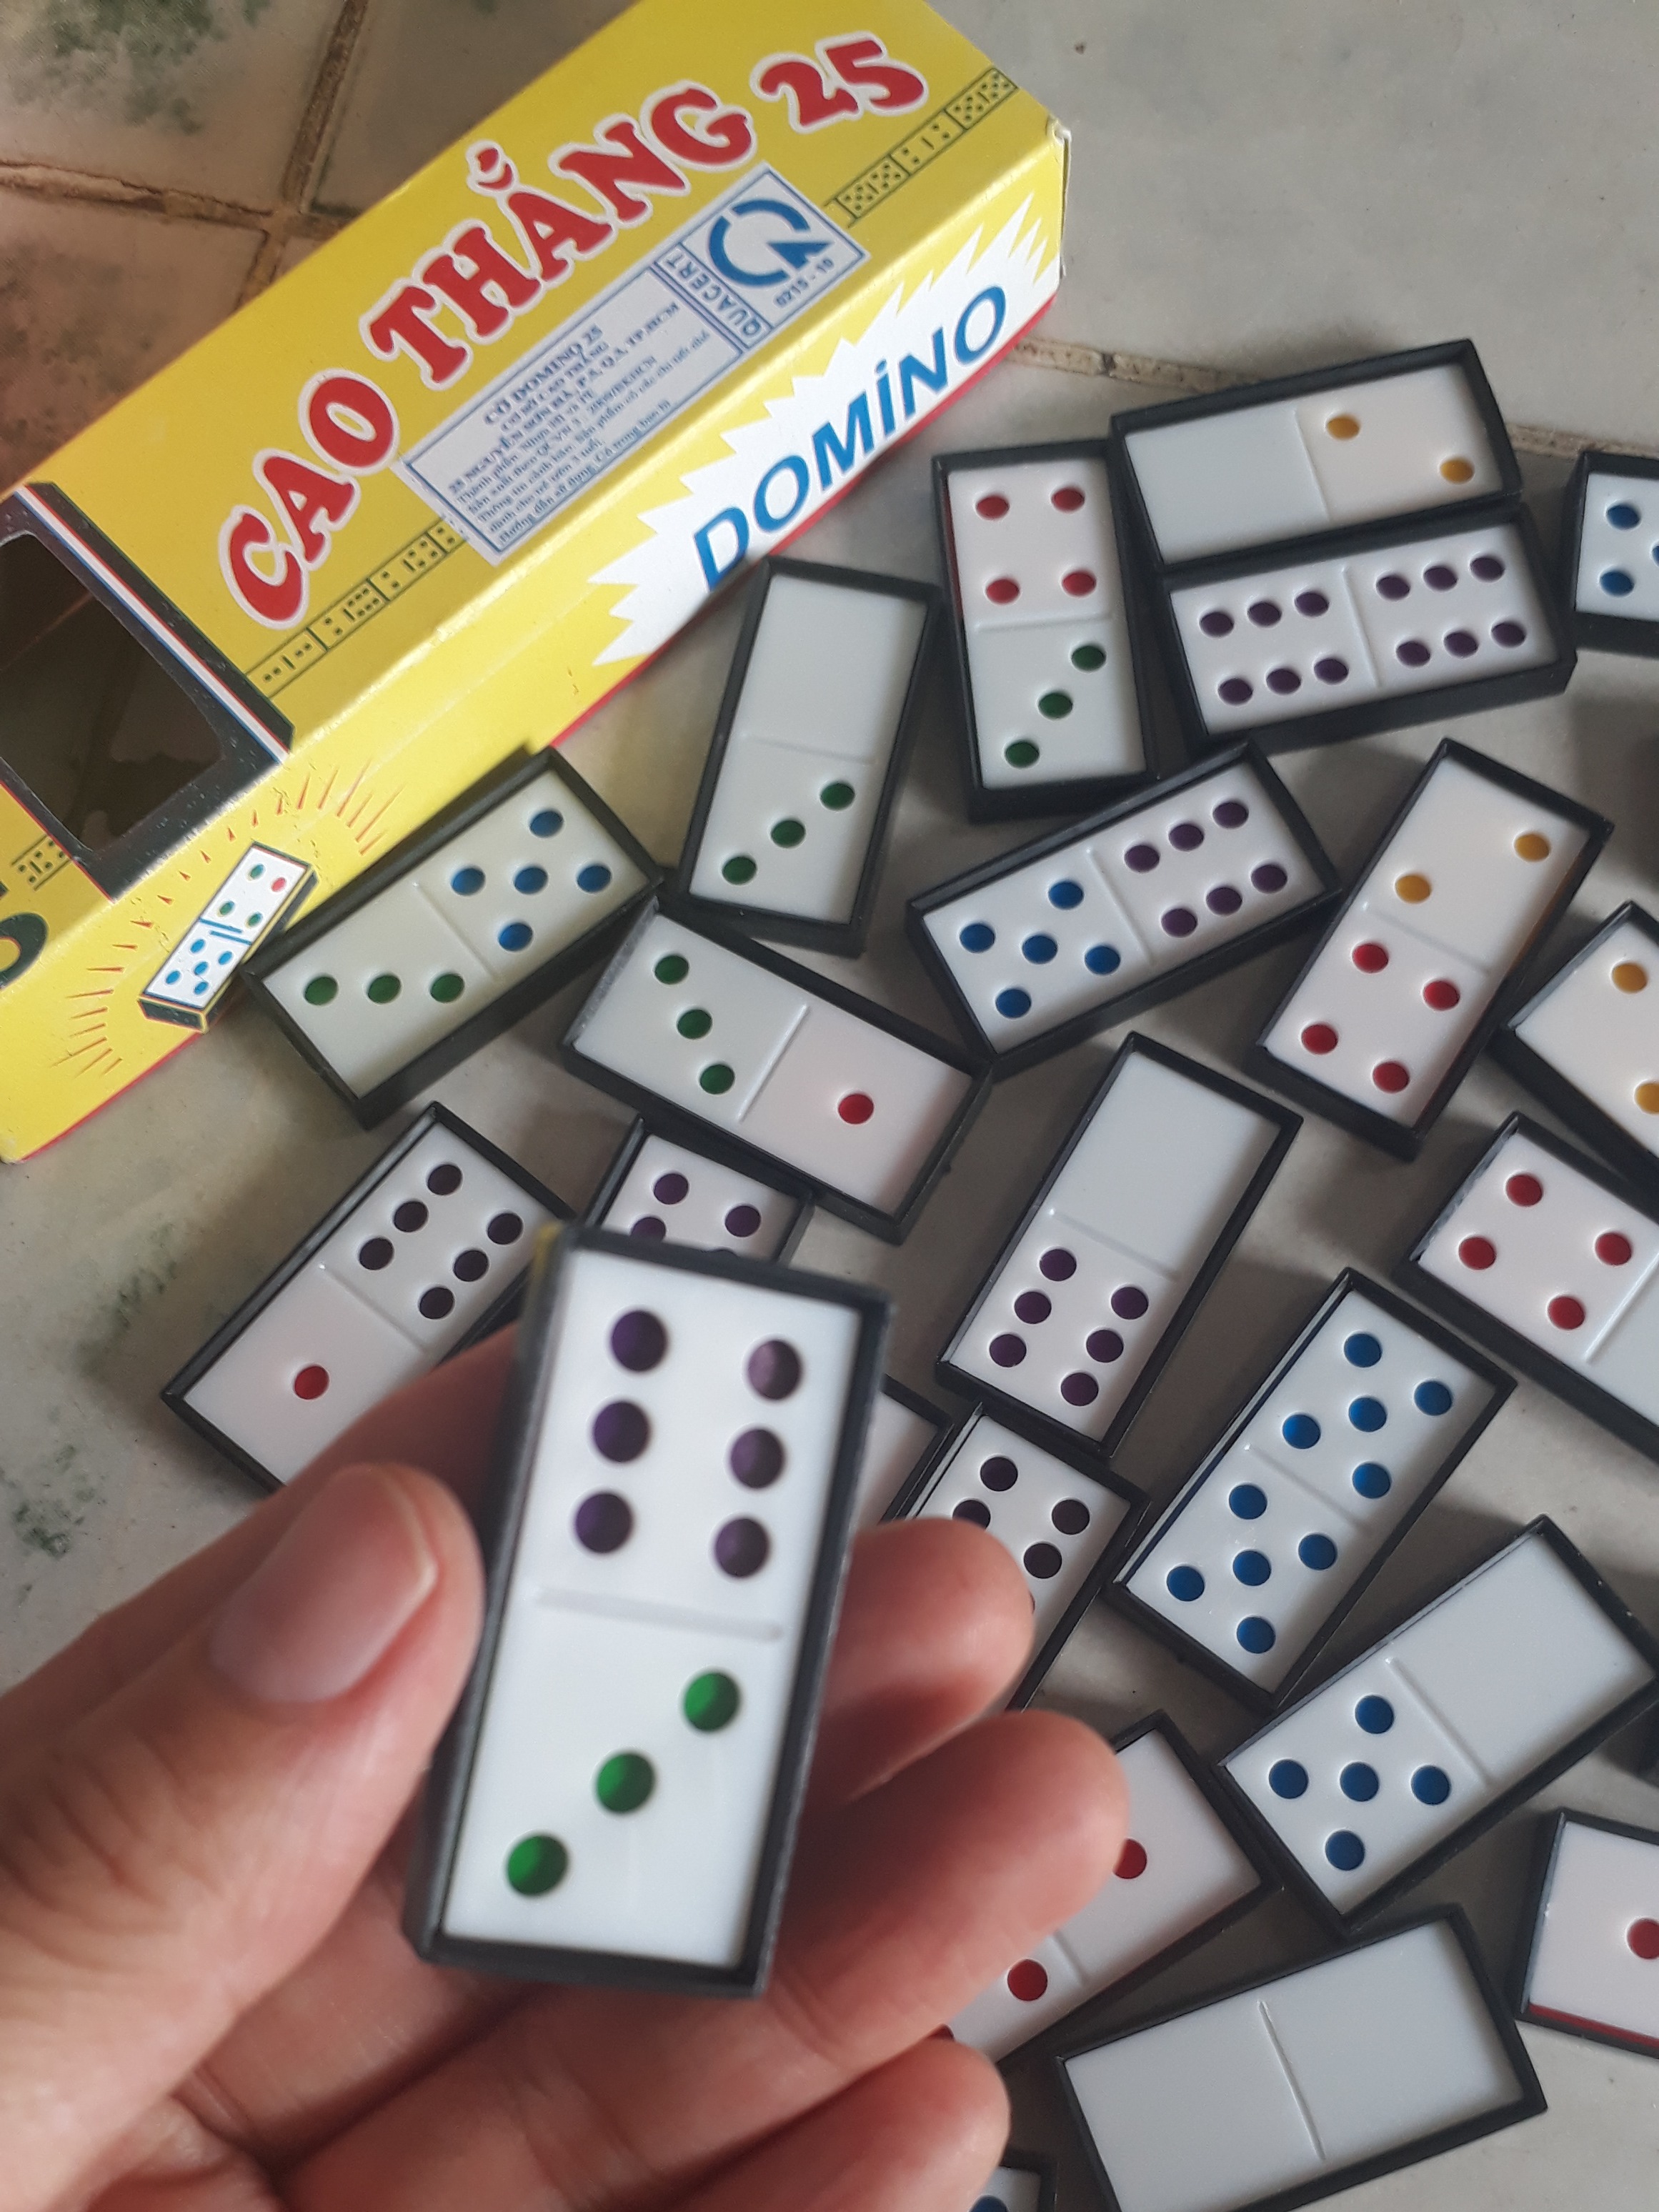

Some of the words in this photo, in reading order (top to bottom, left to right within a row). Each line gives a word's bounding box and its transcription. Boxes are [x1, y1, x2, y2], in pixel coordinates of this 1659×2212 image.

[230, 378, 392, 619] CAO
[370, 89, 752, 384] THẮNG
[761, 41, 922, 124] 25
[665, 250, 762, 338] QUACERT
[511, 341, 584, 402] DOMINO
[579, 324, 603, 344] 25
